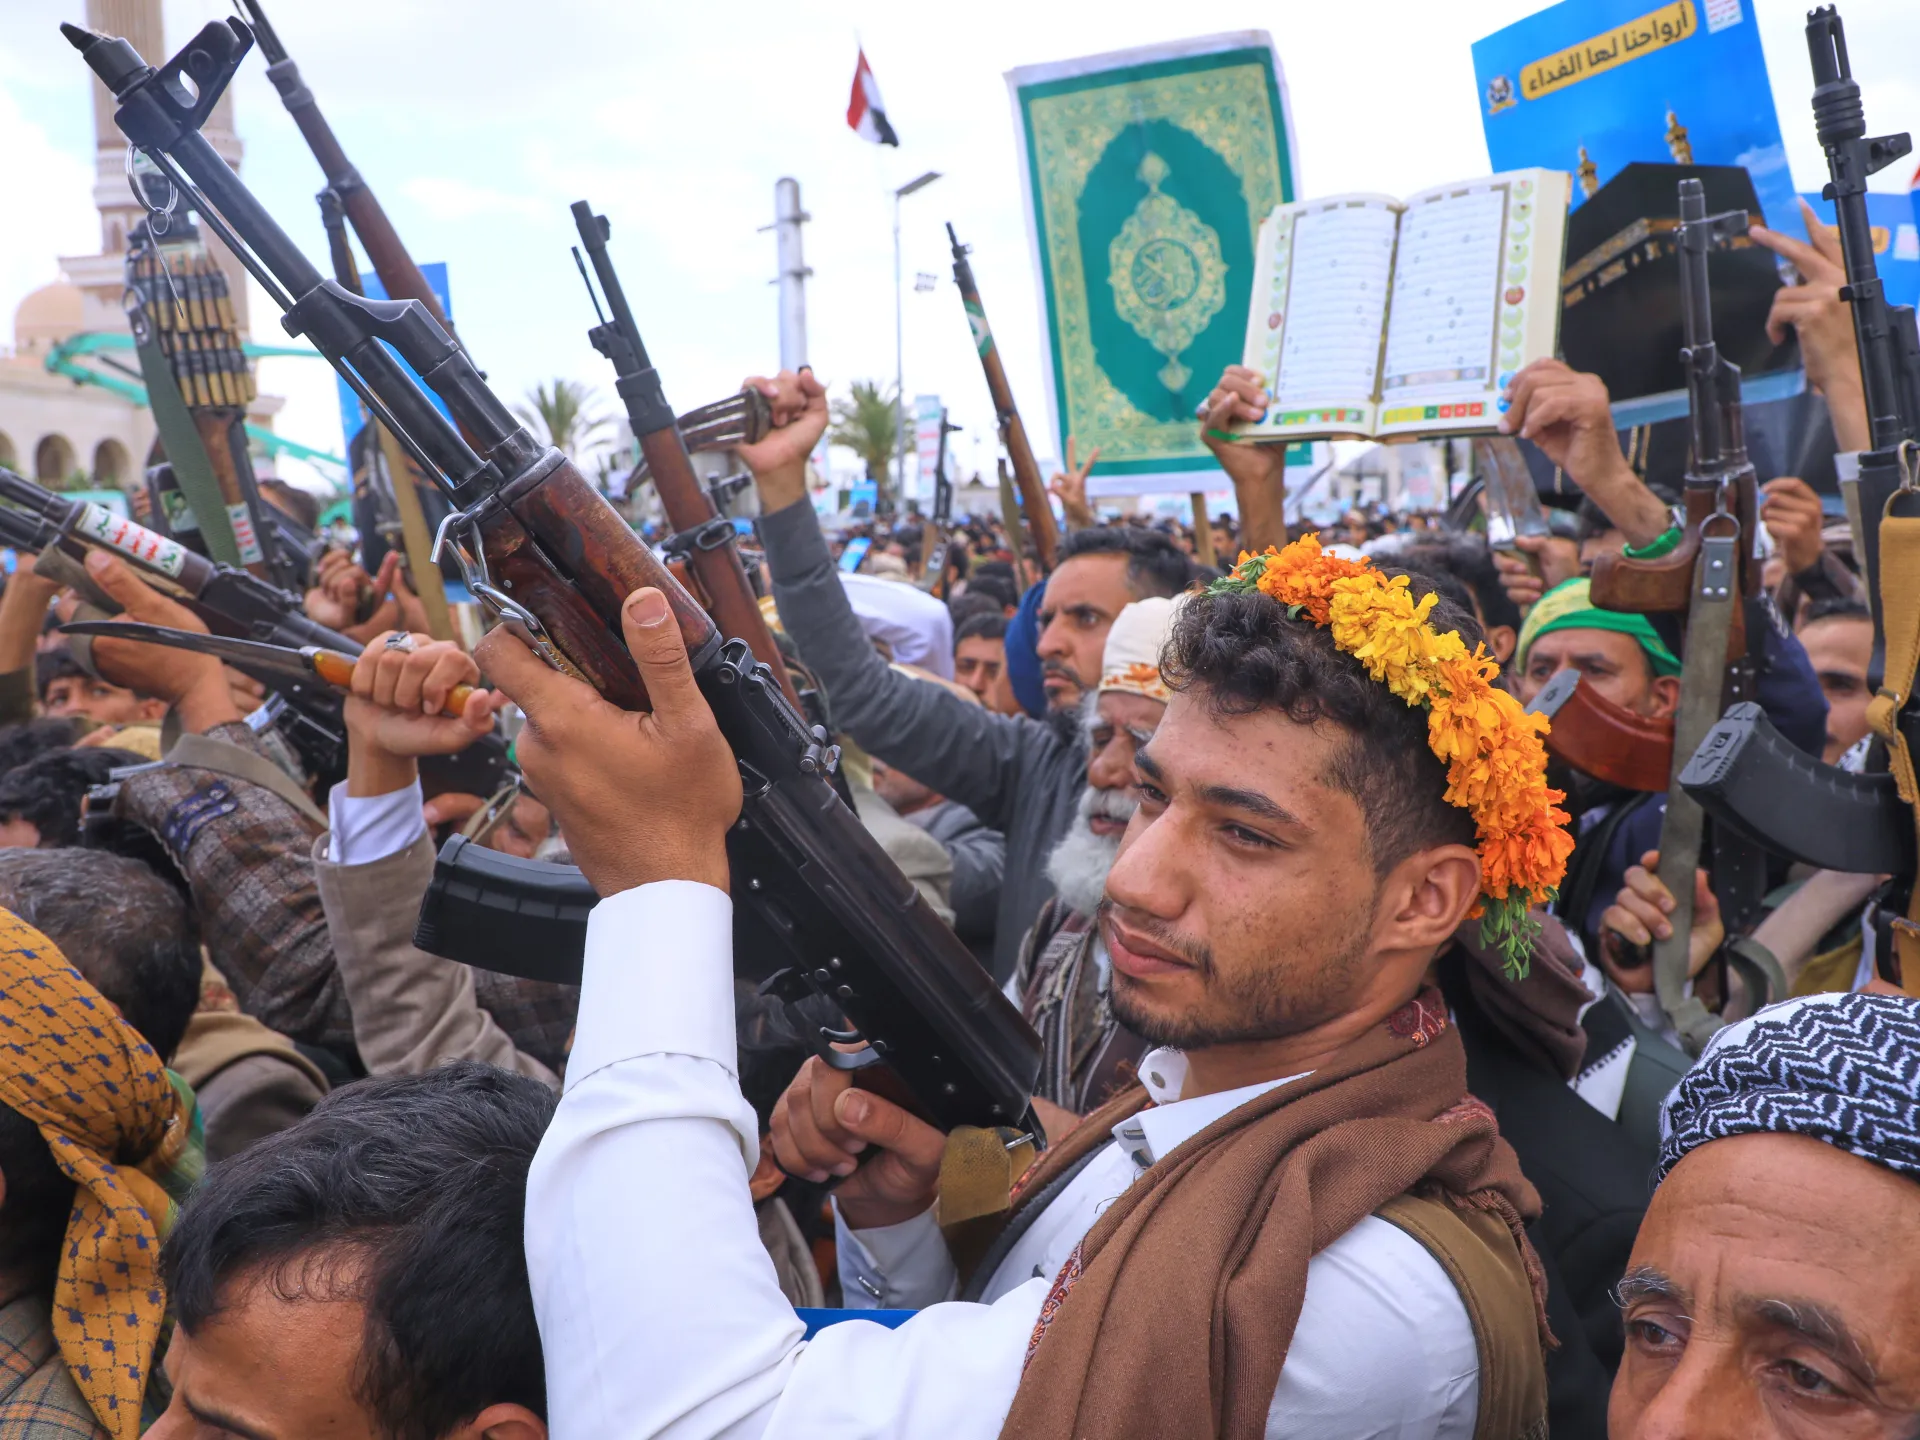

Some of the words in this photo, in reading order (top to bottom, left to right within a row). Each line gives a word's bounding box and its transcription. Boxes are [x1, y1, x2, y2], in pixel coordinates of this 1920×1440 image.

[1622, 1, 1689, 53] أرواحنا
[1528, 51, 1583, 92] الفداء
[1586, 36, 1619, 68] لها
